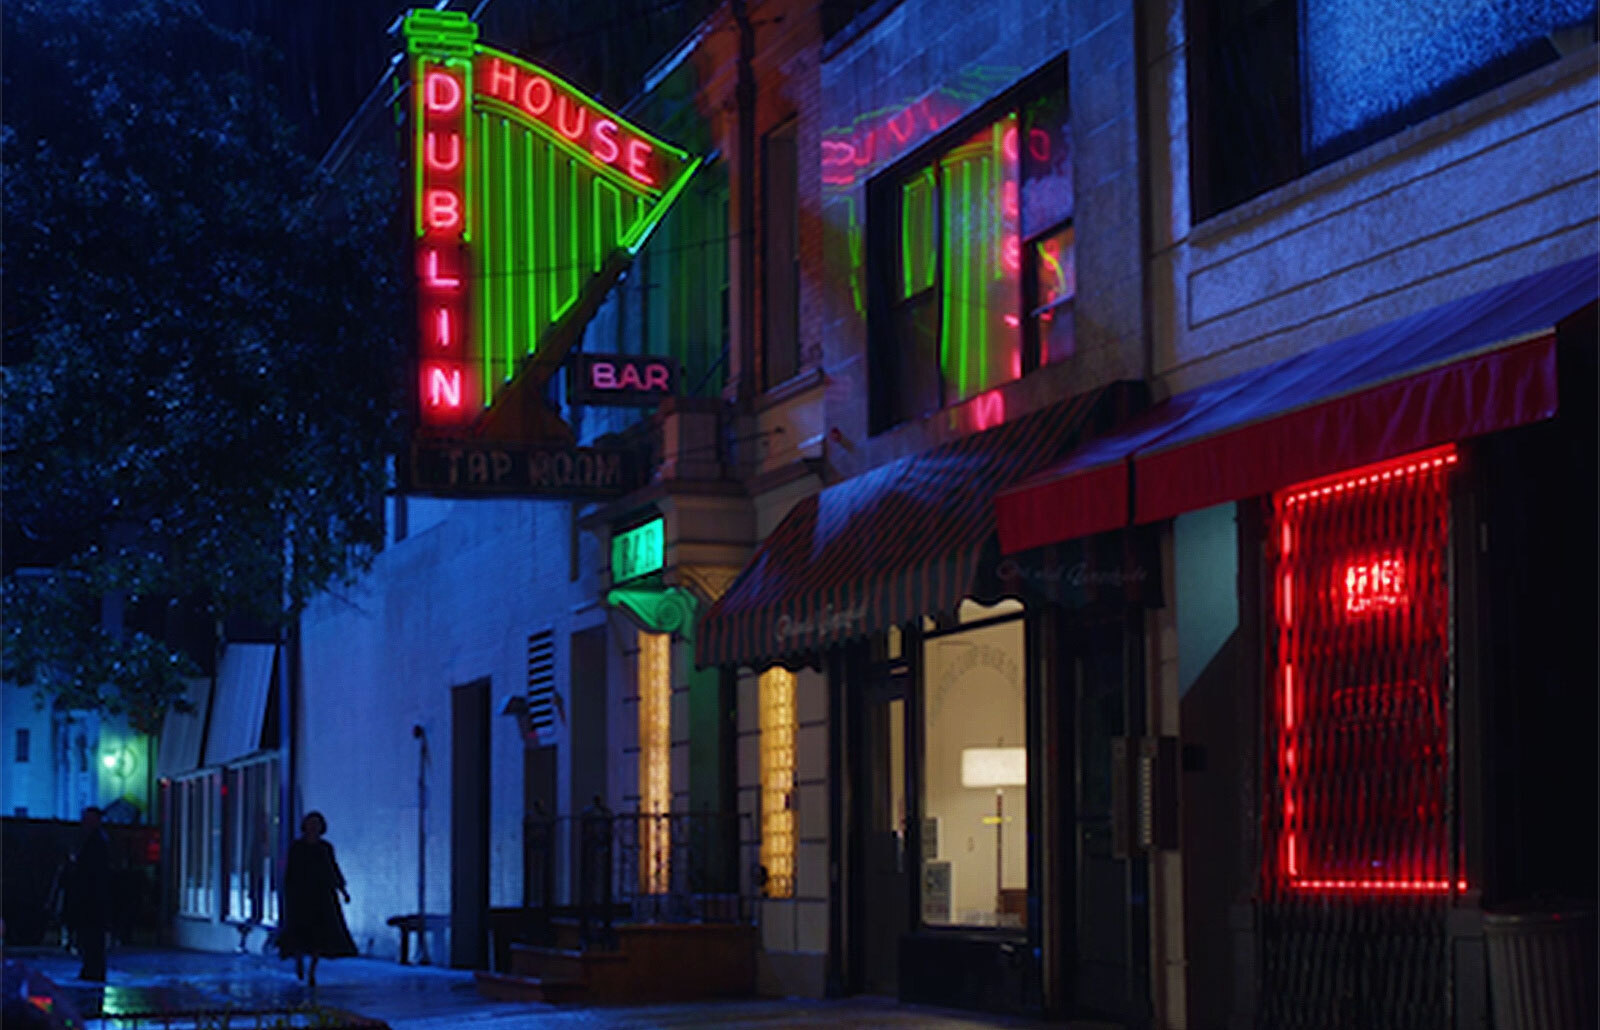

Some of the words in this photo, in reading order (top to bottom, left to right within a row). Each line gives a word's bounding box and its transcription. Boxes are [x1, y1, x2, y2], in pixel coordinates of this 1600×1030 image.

[491, 58, 654, 185] HOUSE
[425, 71, 462, 406] DUBLIN
[591, 362, 669, 391] BAR
[447, 450, 513, 485] TAP
[528, 451, 622, 488] ROOM
